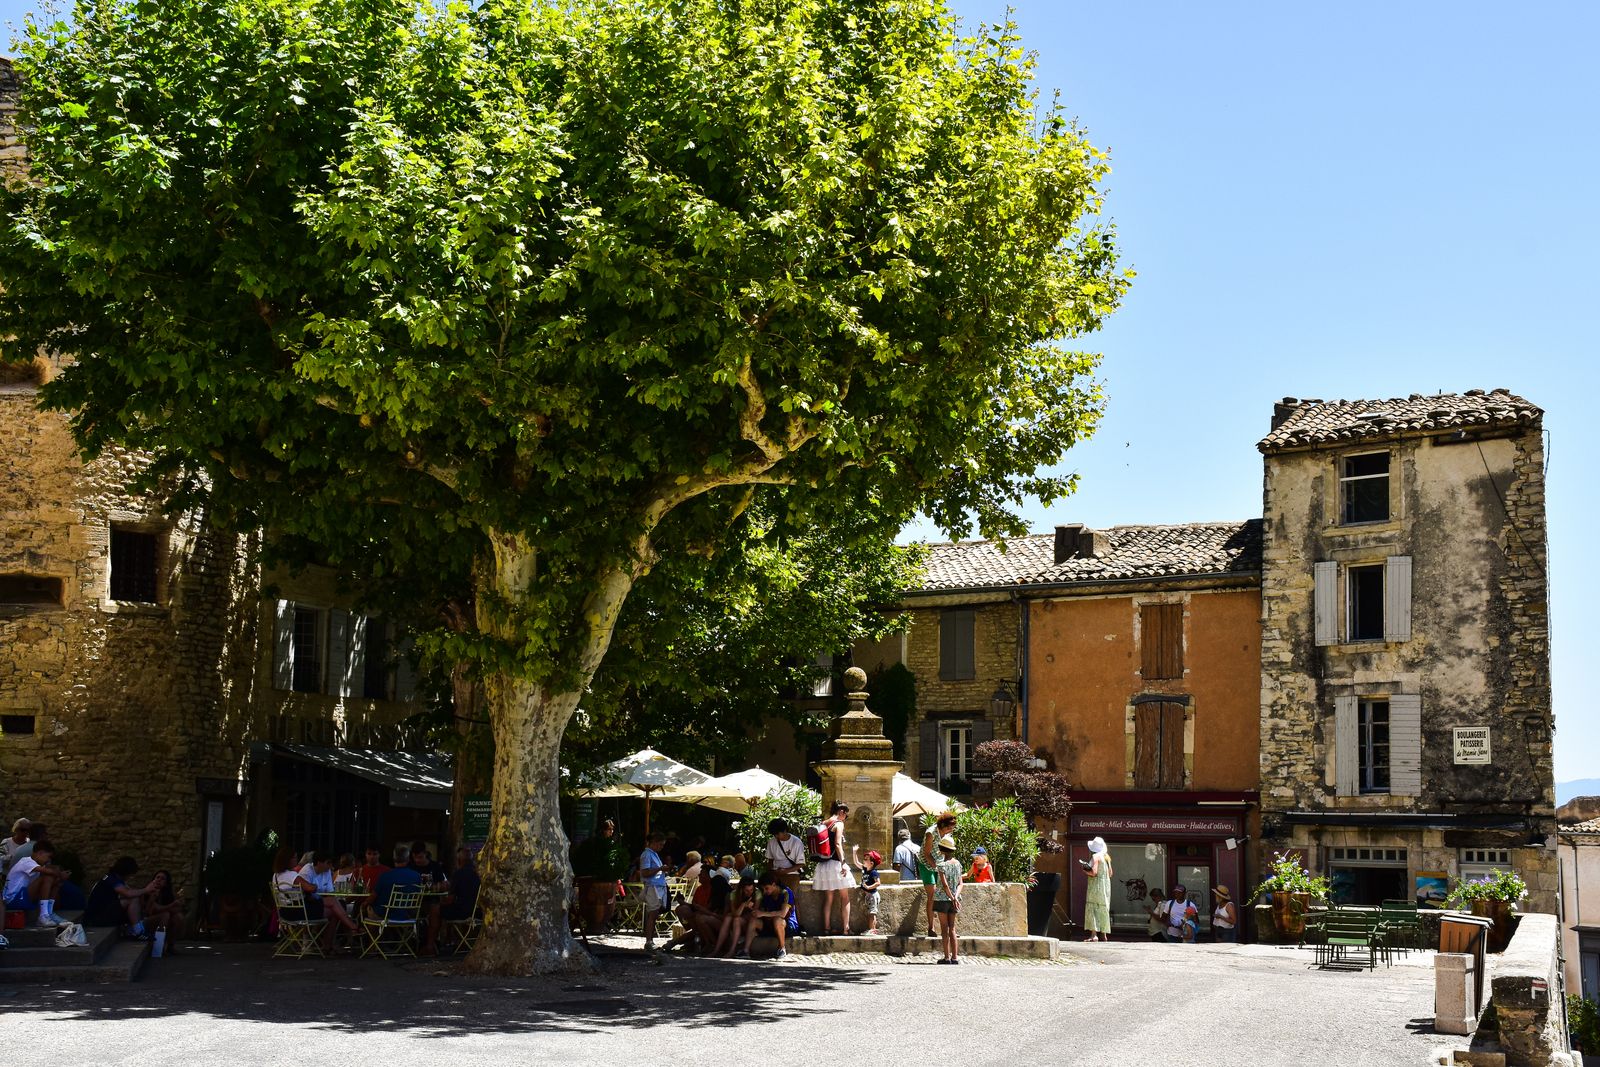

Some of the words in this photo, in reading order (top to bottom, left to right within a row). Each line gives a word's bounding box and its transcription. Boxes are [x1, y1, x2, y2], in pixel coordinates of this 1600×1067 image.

[1457, 731, 1486, 739] BOULANGERIE
[1079, 820, 1106, 828] Lavande
[1108, 821, 1123, 829] Miel
[1125, 821, 1148, 829] Savons
[1152, 821, 1187, 829] artisanaux
[1189, 821, 1207, 829] Huile
